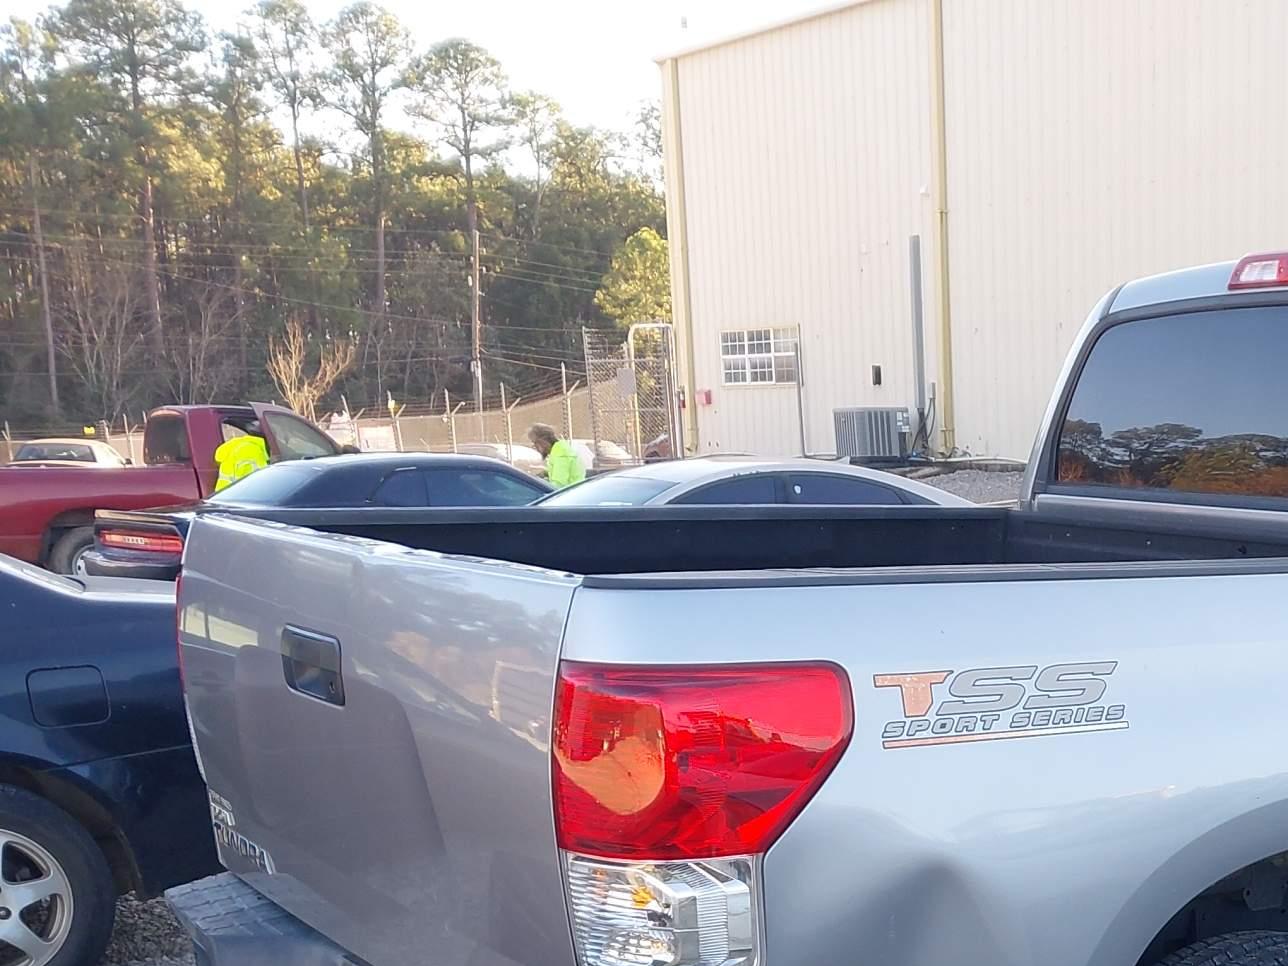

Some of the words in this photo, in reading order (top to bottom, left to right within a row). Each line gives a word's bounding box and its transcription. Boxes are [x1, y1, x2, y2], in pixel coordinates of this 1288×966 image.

[873, 661, 1118, 718] TSS
[881, 714, 1000, 738] SPORT
[1009, 704, 1125, 728] SERIES
